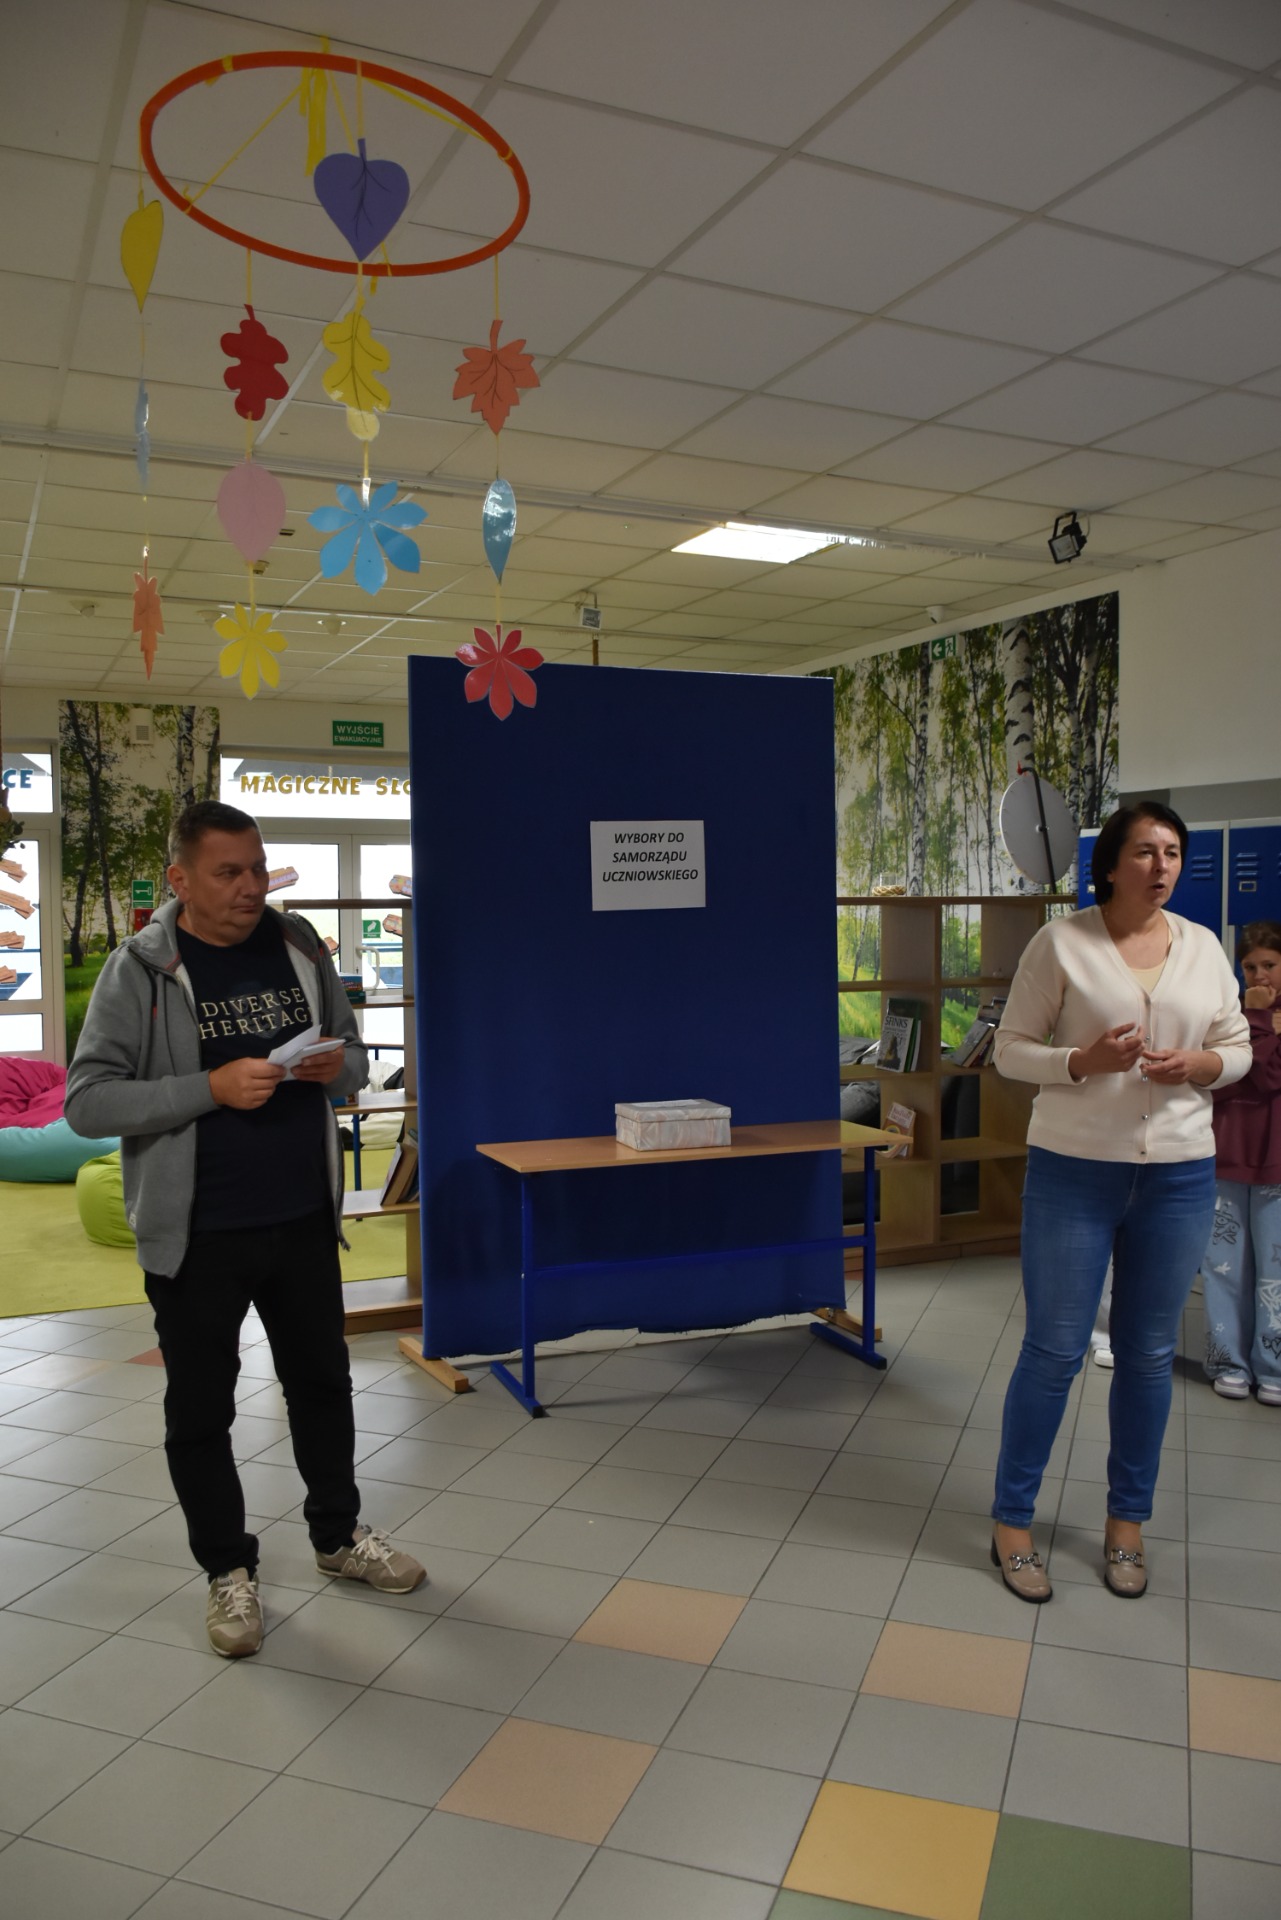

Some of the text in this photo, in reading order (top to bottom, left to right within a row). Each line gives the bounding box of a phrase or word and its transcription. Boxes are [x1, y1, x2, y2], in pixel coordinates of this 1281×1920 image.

[336, 724, 380, 735] WYJŚCIE
[334, 735, 383, 743] EWAKUACYJNE
[240, 774, 362, 795] MAGICZNE
[614, 832, 684, 843] WYBORY DO
[612, 851, 687, 864] SAMORZĄDU
[602, 869, 699, 882] UCZNIOWSKIEGO
[200, 987, 305, 1018] DIVERSE
[199, 1006, 313, 1040] HERITAG
